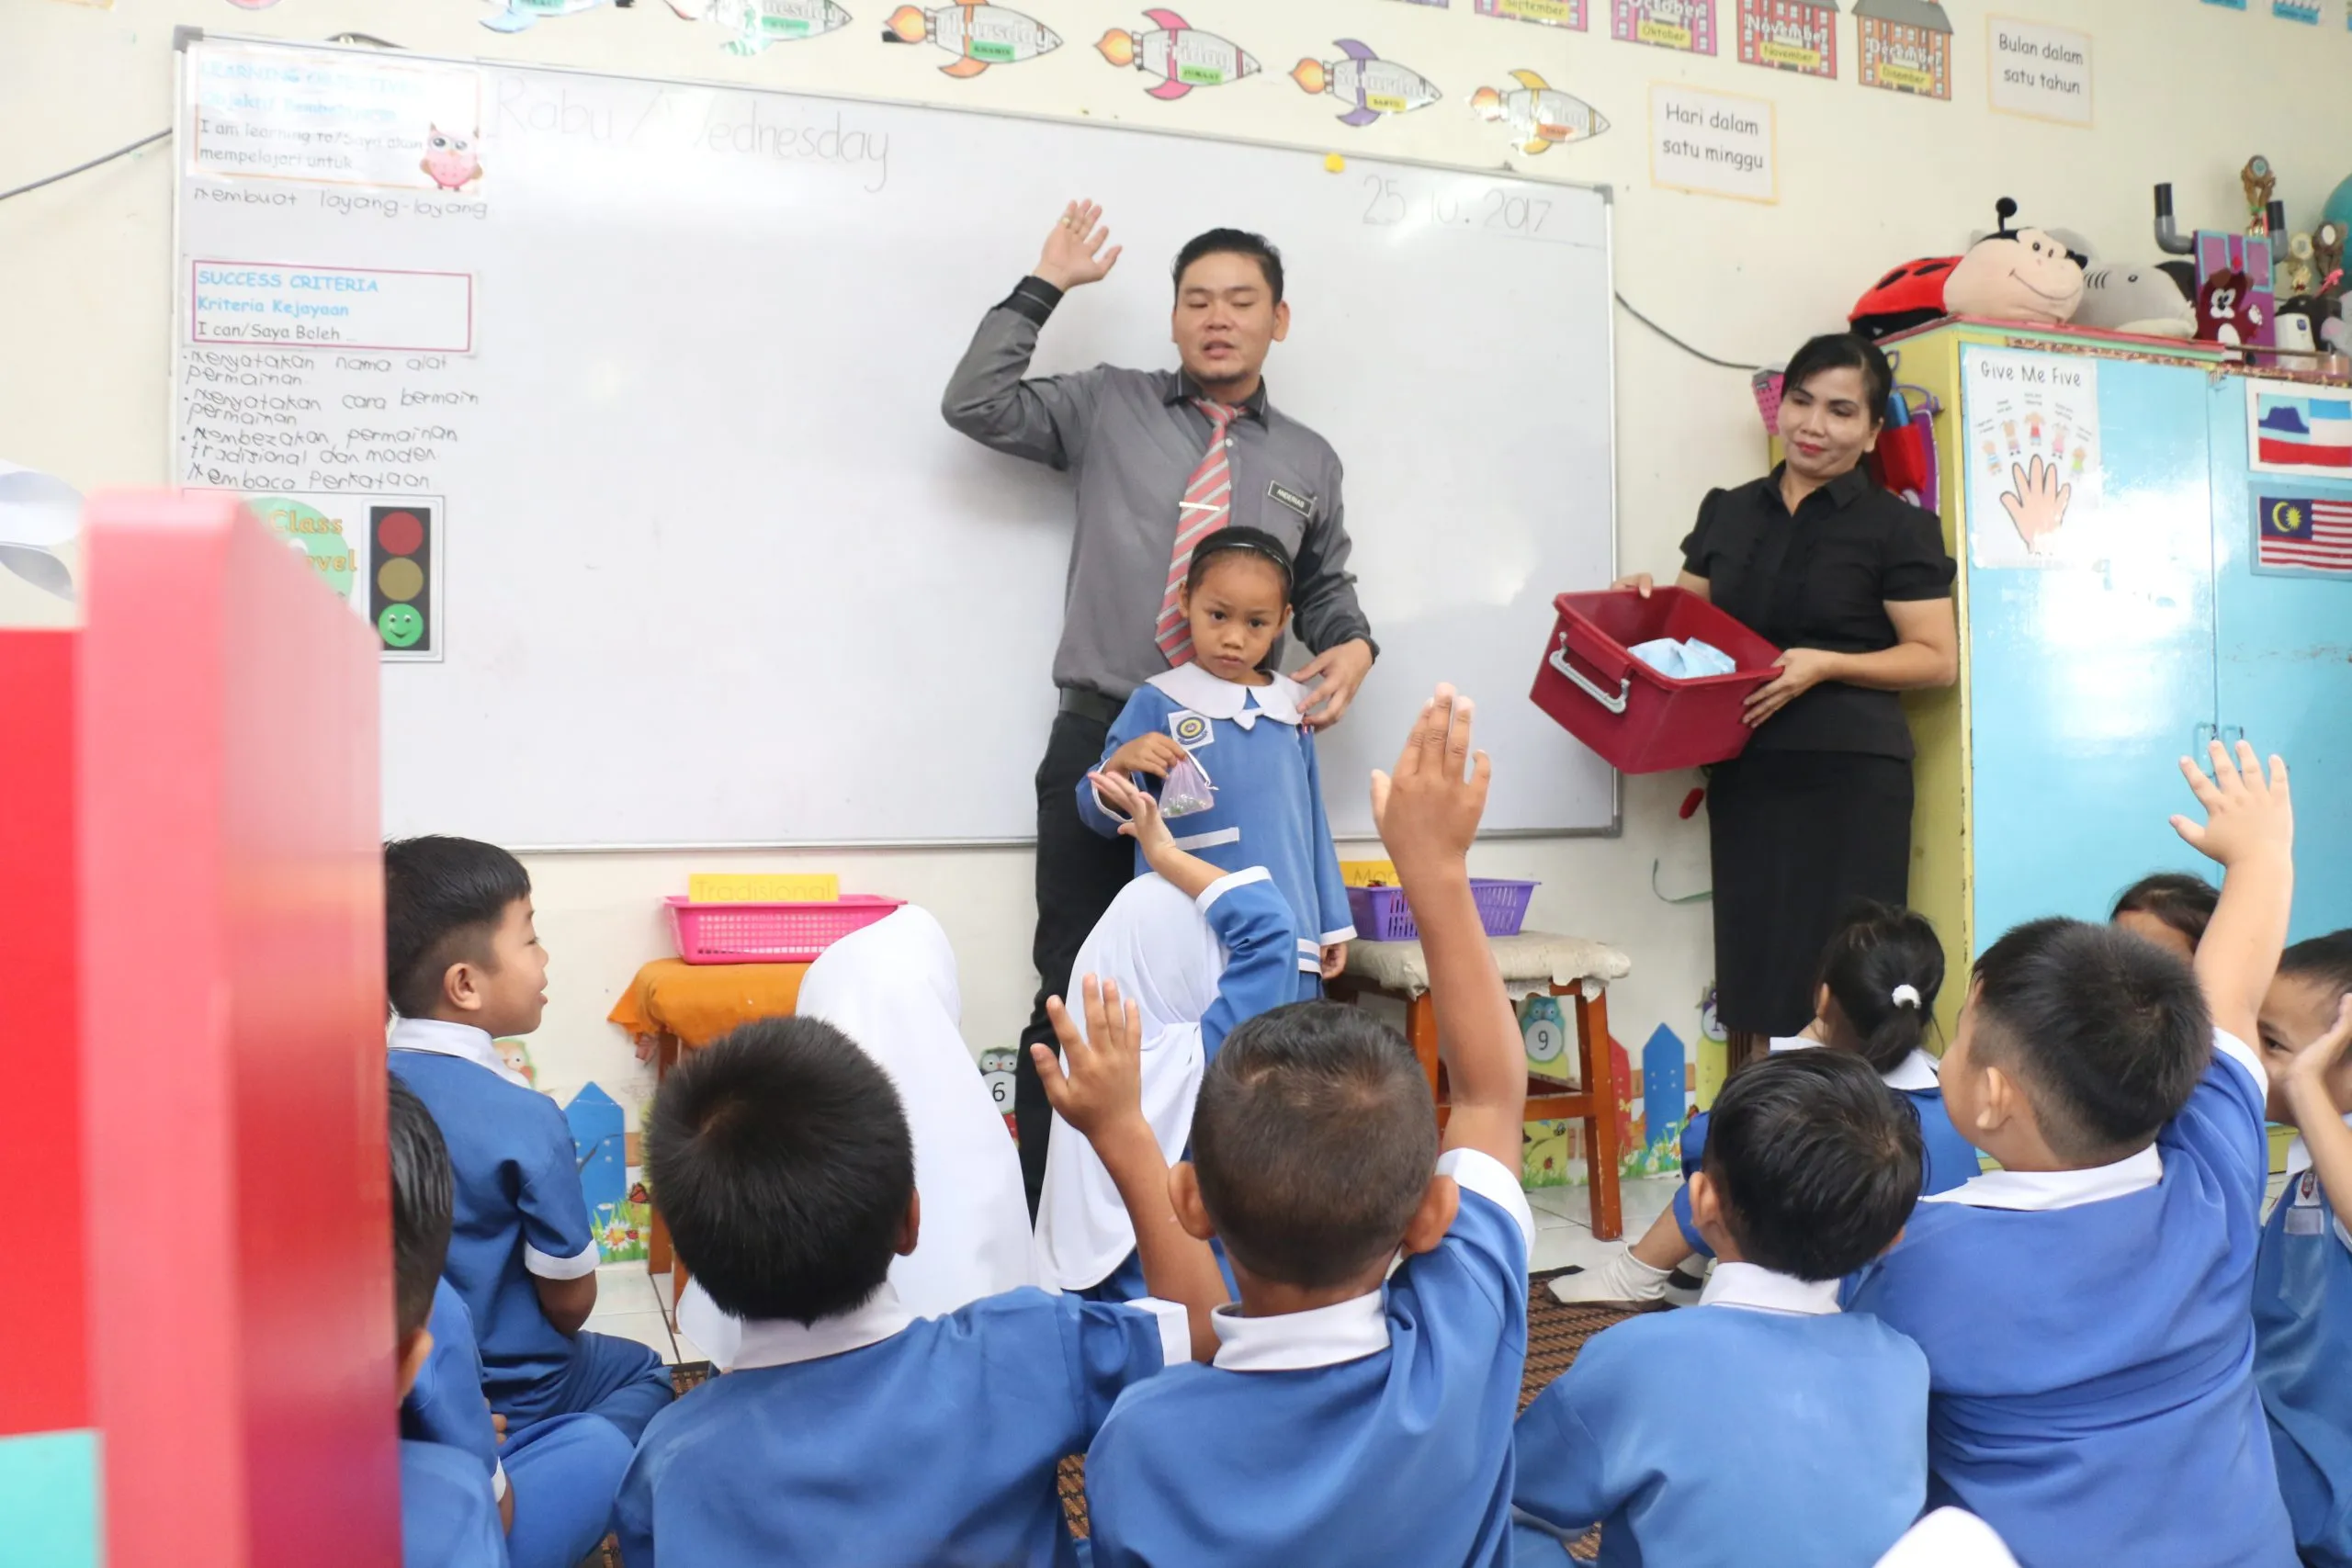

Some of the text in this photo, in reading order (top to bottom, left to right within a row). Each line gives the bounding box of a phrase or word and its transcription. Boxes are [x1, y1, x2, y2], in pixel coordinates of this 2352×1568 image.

[1643, 25, 1686, 41] Oktober
[1747, 14, 1826, 43] November
[1764, 45, 1814, 61] November
[1869, 38, 1941, 66] December
[1999, 33, 2083, 65] Bulan dalam
[1883, 65, 1926, 84] Disember
[2004, 68, 2080, 95] satu tahun
[496, 75, 613, 141] Rabu
[1667, 102, 1758, 136] Hari dalam
[216, 124, 239, 136] am
[245, 123, 311, 143] learning
[200, 147, 353, 170] mempelajari untuk
[1663, 139, 1763, 173] satu minggu
[198, 270, 379, 293] SUCCESS CRITERIA
[198, 296, 349, 319] Kriteria Kejayaan
[197, 321, 207, 335] I
[297, 325, 340, 341] Boleh
[336, 355, 392, 373] nama
[406, 354, 447, 372] alat
[1981, 360, 2081, 387] Give Me Five
[342, 393, 386, 410] cara
[401, 388, 480, 407] bermain
[346, 426, 458, 448] permainan
[320, 445, 360, 464] dan
[270, 509, 343, 535] Class
[695, 878, 831, 901] Tradisional
[1537, 1030, 1549, 1051] 9
[992, 1081, 1005, 1102] 6
